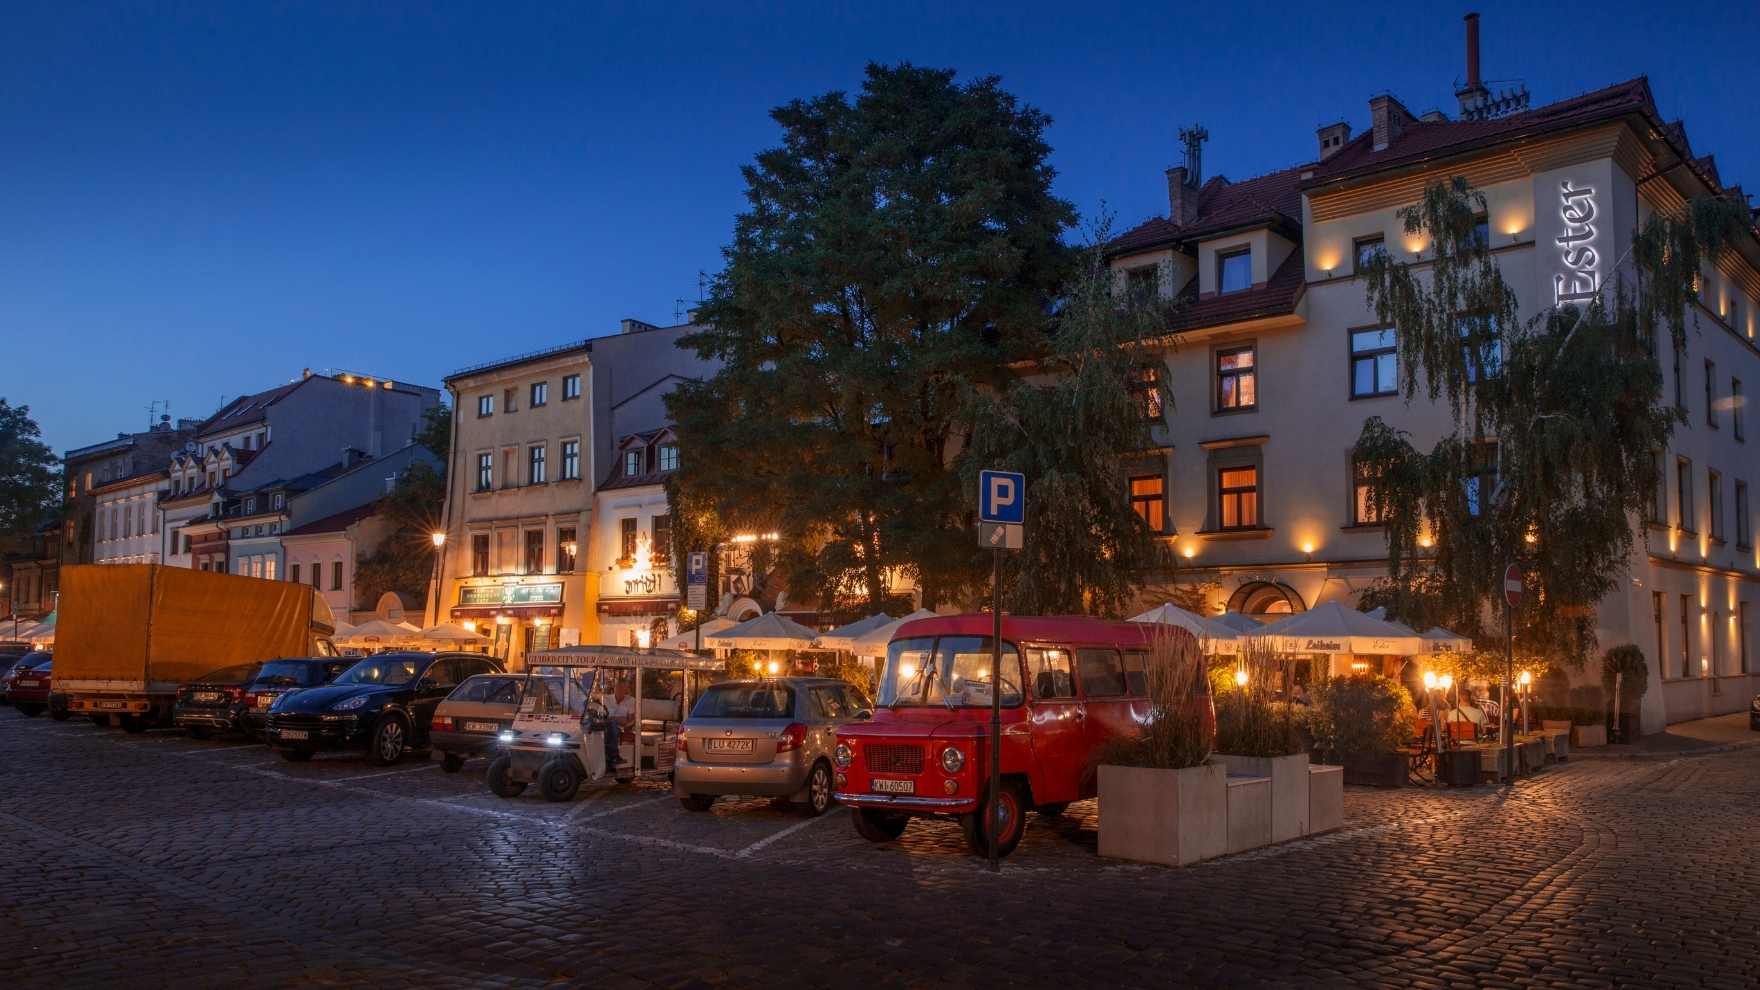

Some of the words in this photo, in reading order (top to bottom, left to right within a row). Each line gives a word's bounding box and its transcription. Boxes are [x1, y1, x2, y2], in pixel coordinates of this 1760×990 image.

[1554, 180, 1598, 308] Ester
[991, 477, 1015, 515] P
[691, 555, 703, 574] P
